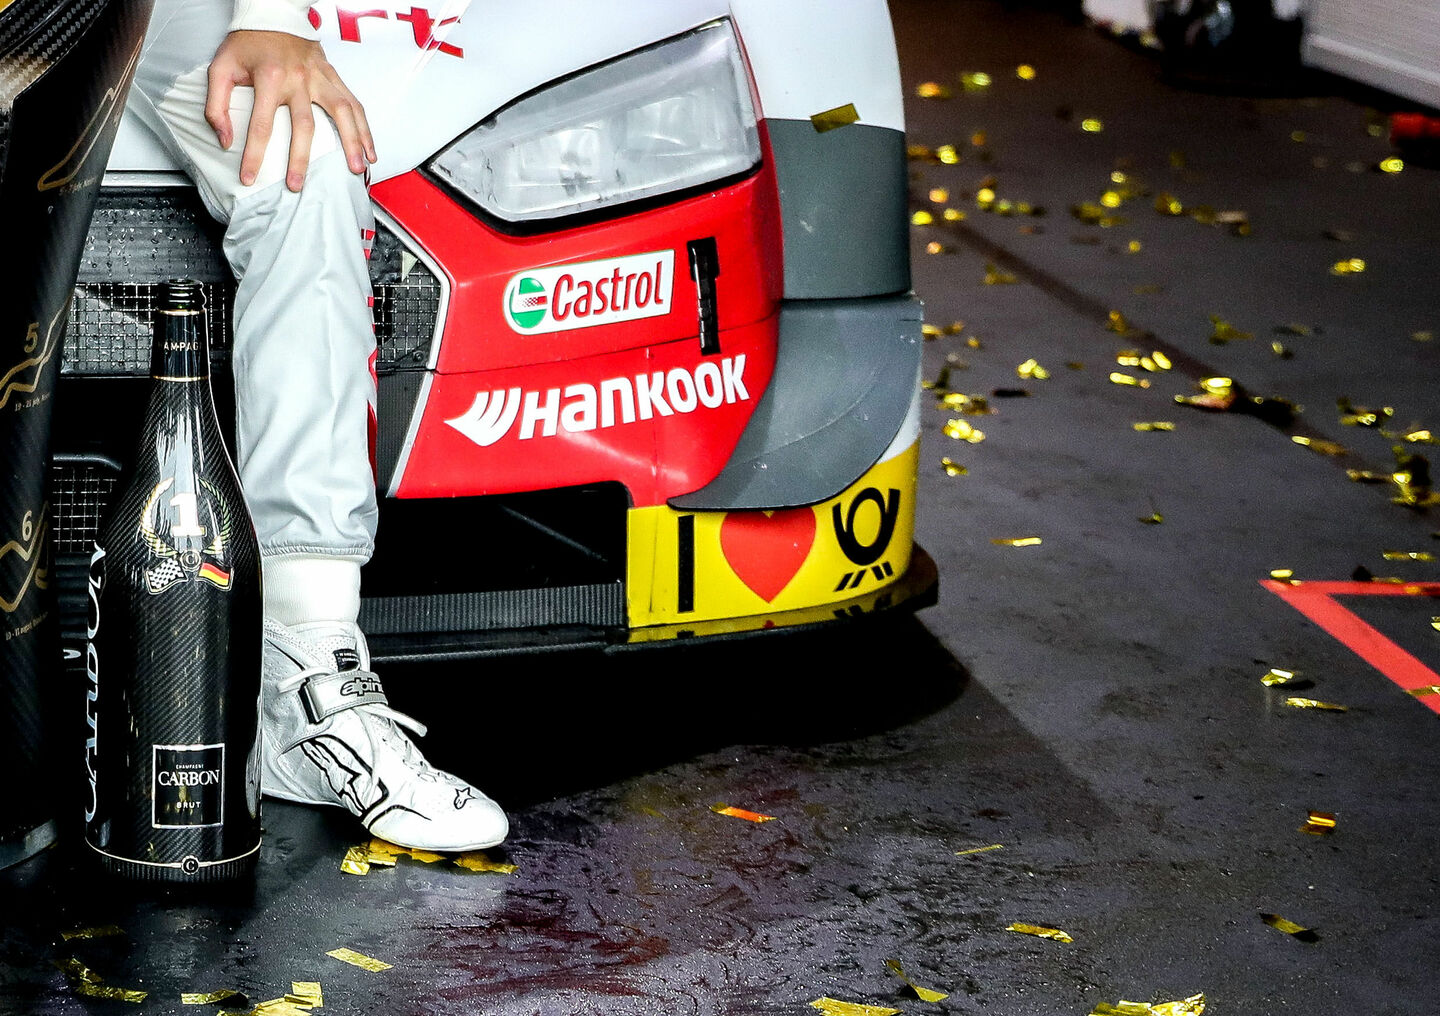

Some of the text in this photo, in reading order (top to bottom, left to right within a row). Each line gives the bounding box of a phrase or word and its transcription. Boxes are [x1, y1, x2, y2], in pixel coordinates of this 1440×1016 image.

[551, 260, 665, 321] Castrol
[24, 322, 39, 353] 5
[22, 510, 32, 541] 6
[169, 492, 207, 537] 1
[158, 769, 220, 786] CARBON
[176, 801, 201, 809] BRUT
